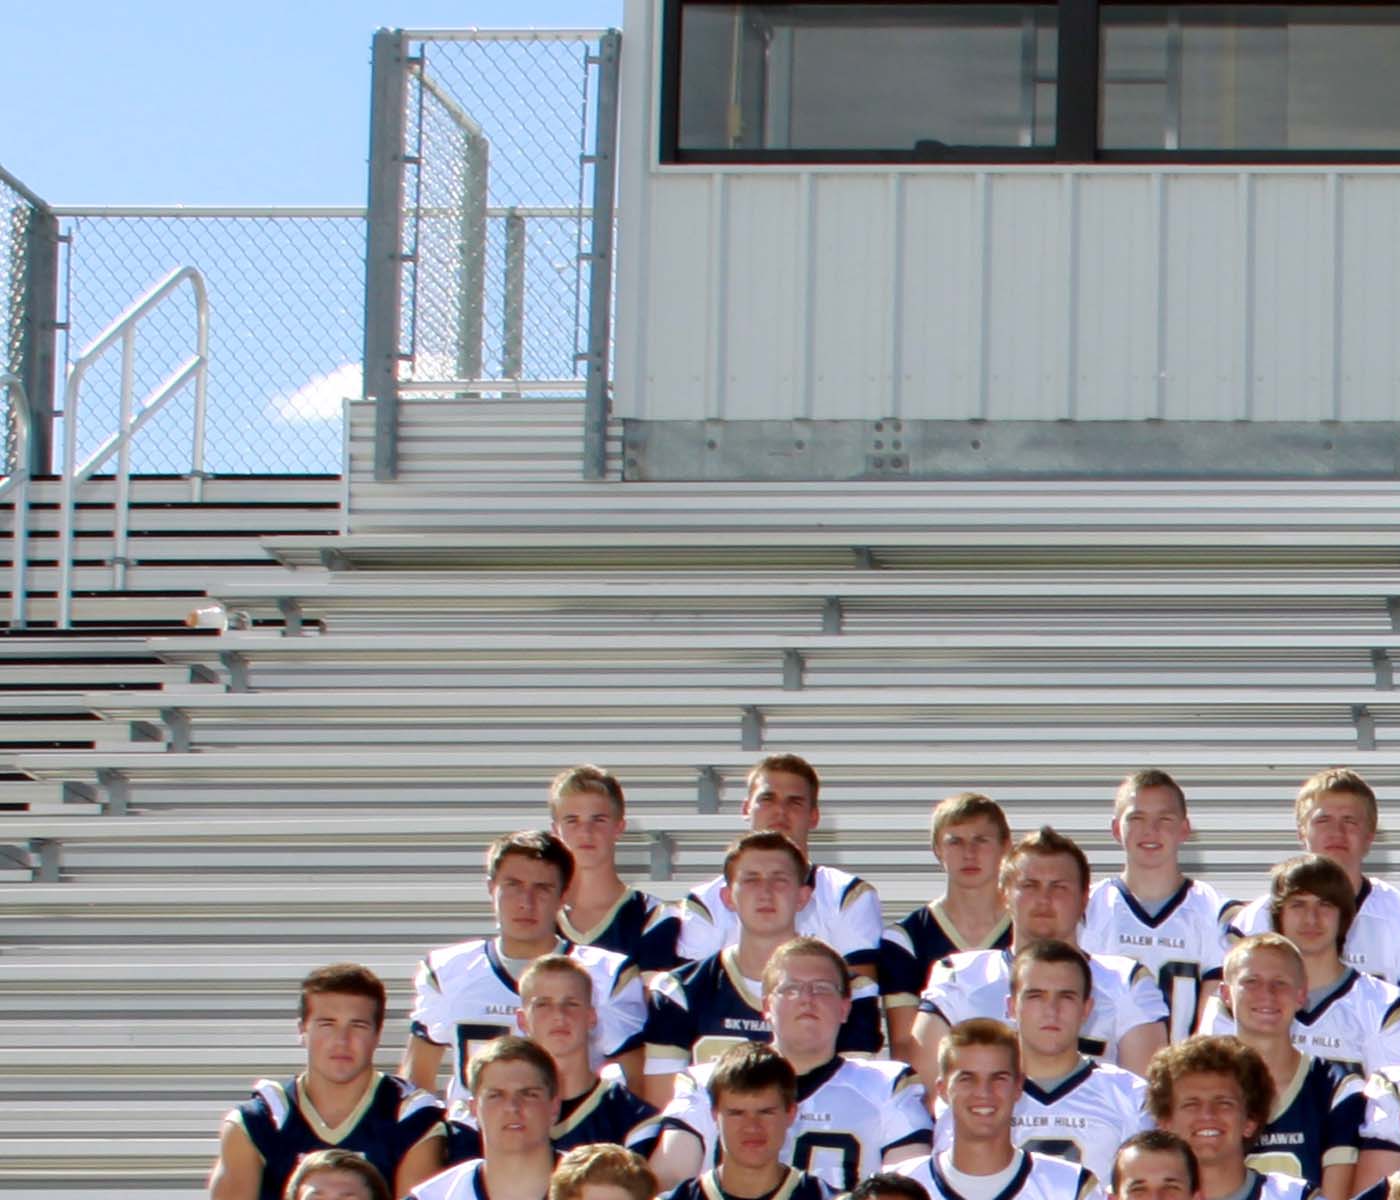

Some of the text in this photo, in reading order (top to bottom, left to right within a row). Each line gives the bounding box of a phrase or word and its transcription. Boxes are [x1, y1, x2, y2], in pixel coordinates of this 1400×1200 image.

[1120, 934, 1185, 949] SALEM HILLS
[800, 1113, 832, 1122] HILLS
[1011, 1115, 1086, 1128] SALEM HILLS
